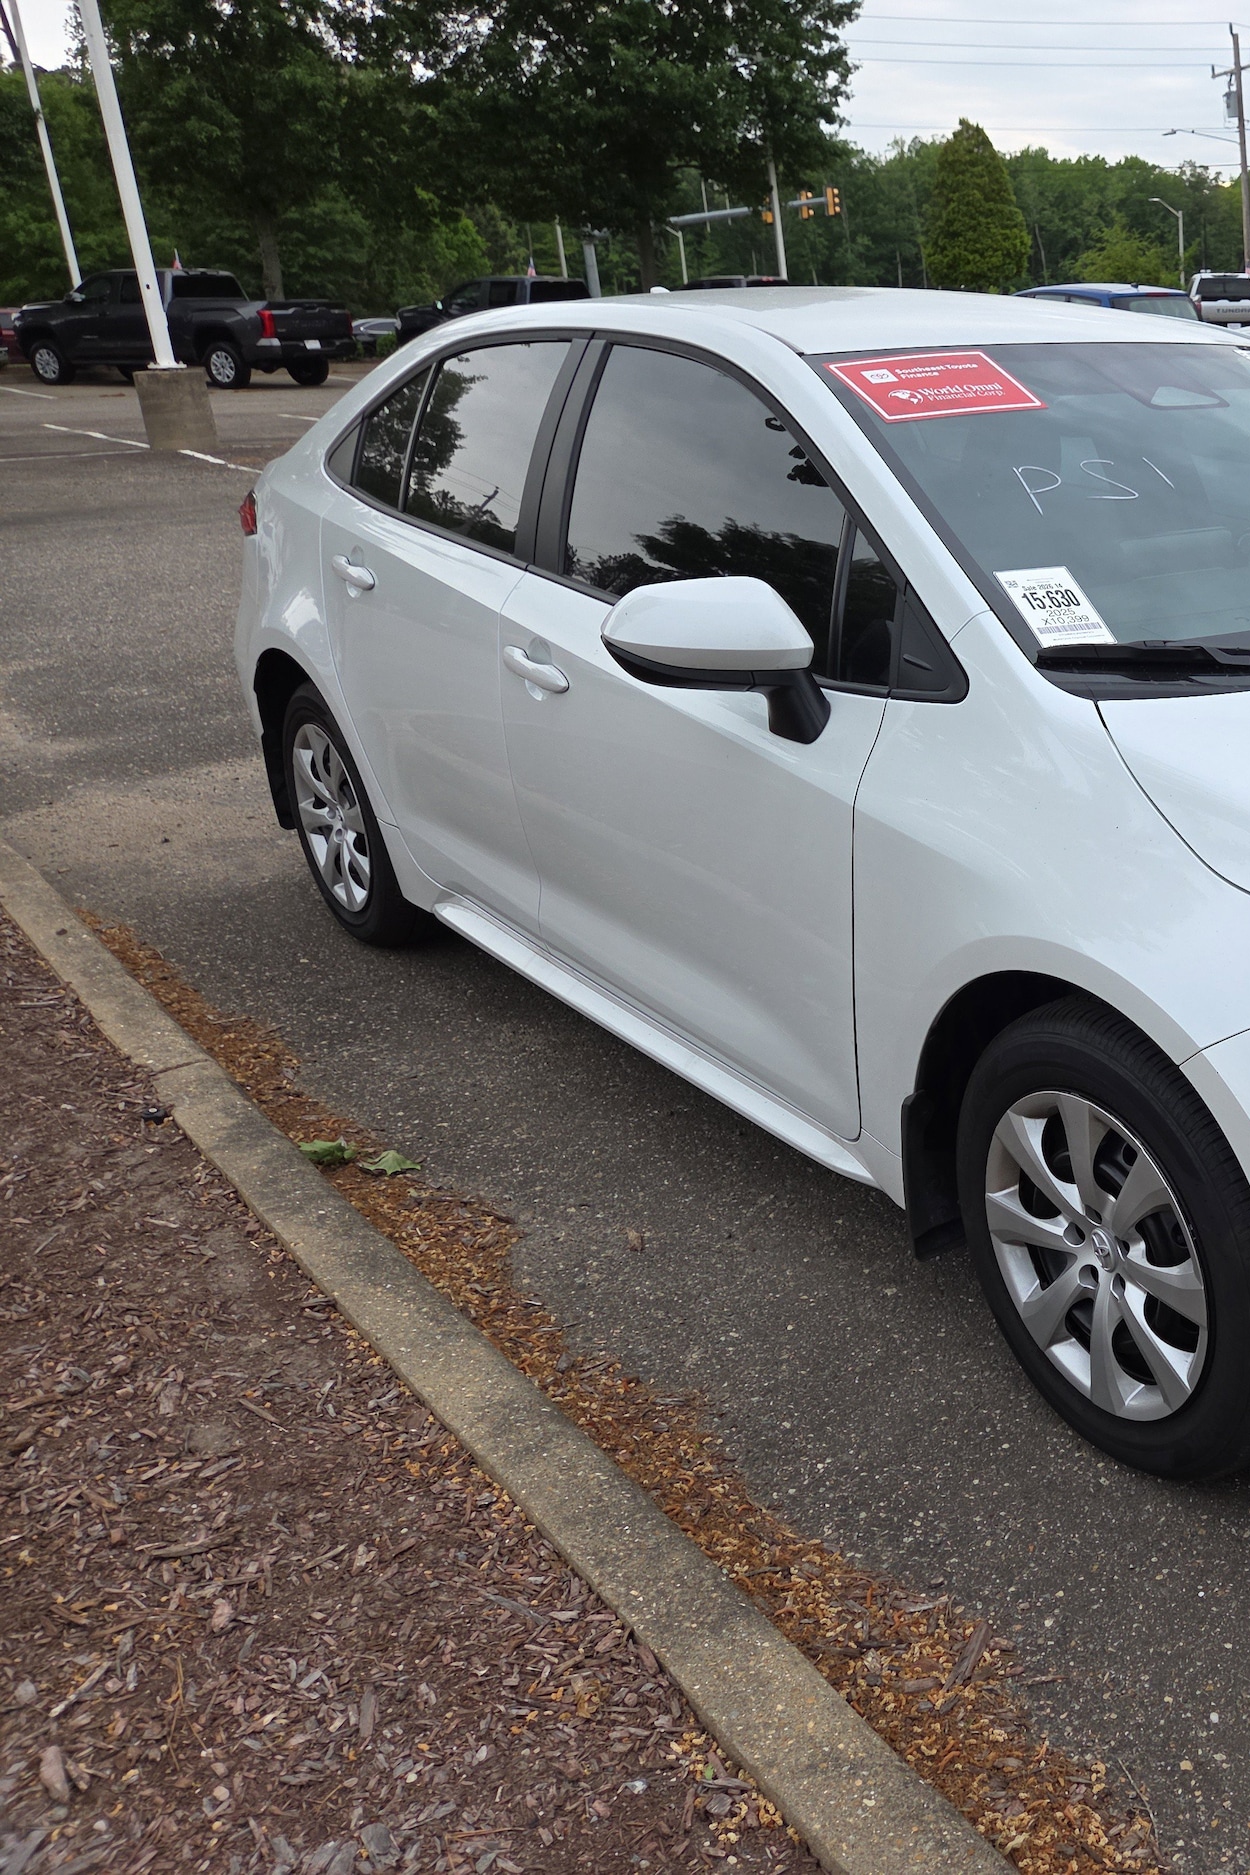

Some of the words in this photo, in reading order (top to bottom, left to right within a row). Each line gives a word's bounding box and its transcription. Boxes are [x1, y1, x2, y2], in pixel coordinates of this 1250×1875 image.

[895, 363, 946, 374] Southeast
[945, 363, 978, 371] Toyota
[901, 371, 940, 379] Finance
[918, 385, 962, 396] World
[963, 382, 1003, 392] Omni
[927, 390, 977, 401] Financial
[979, 390, 1005, 398] Corp.
[1021, 589, 1081, 610] 15:630
[1046, 608, 1076, 617] 2025
[1041, 614, 1090, 626] X10,399
